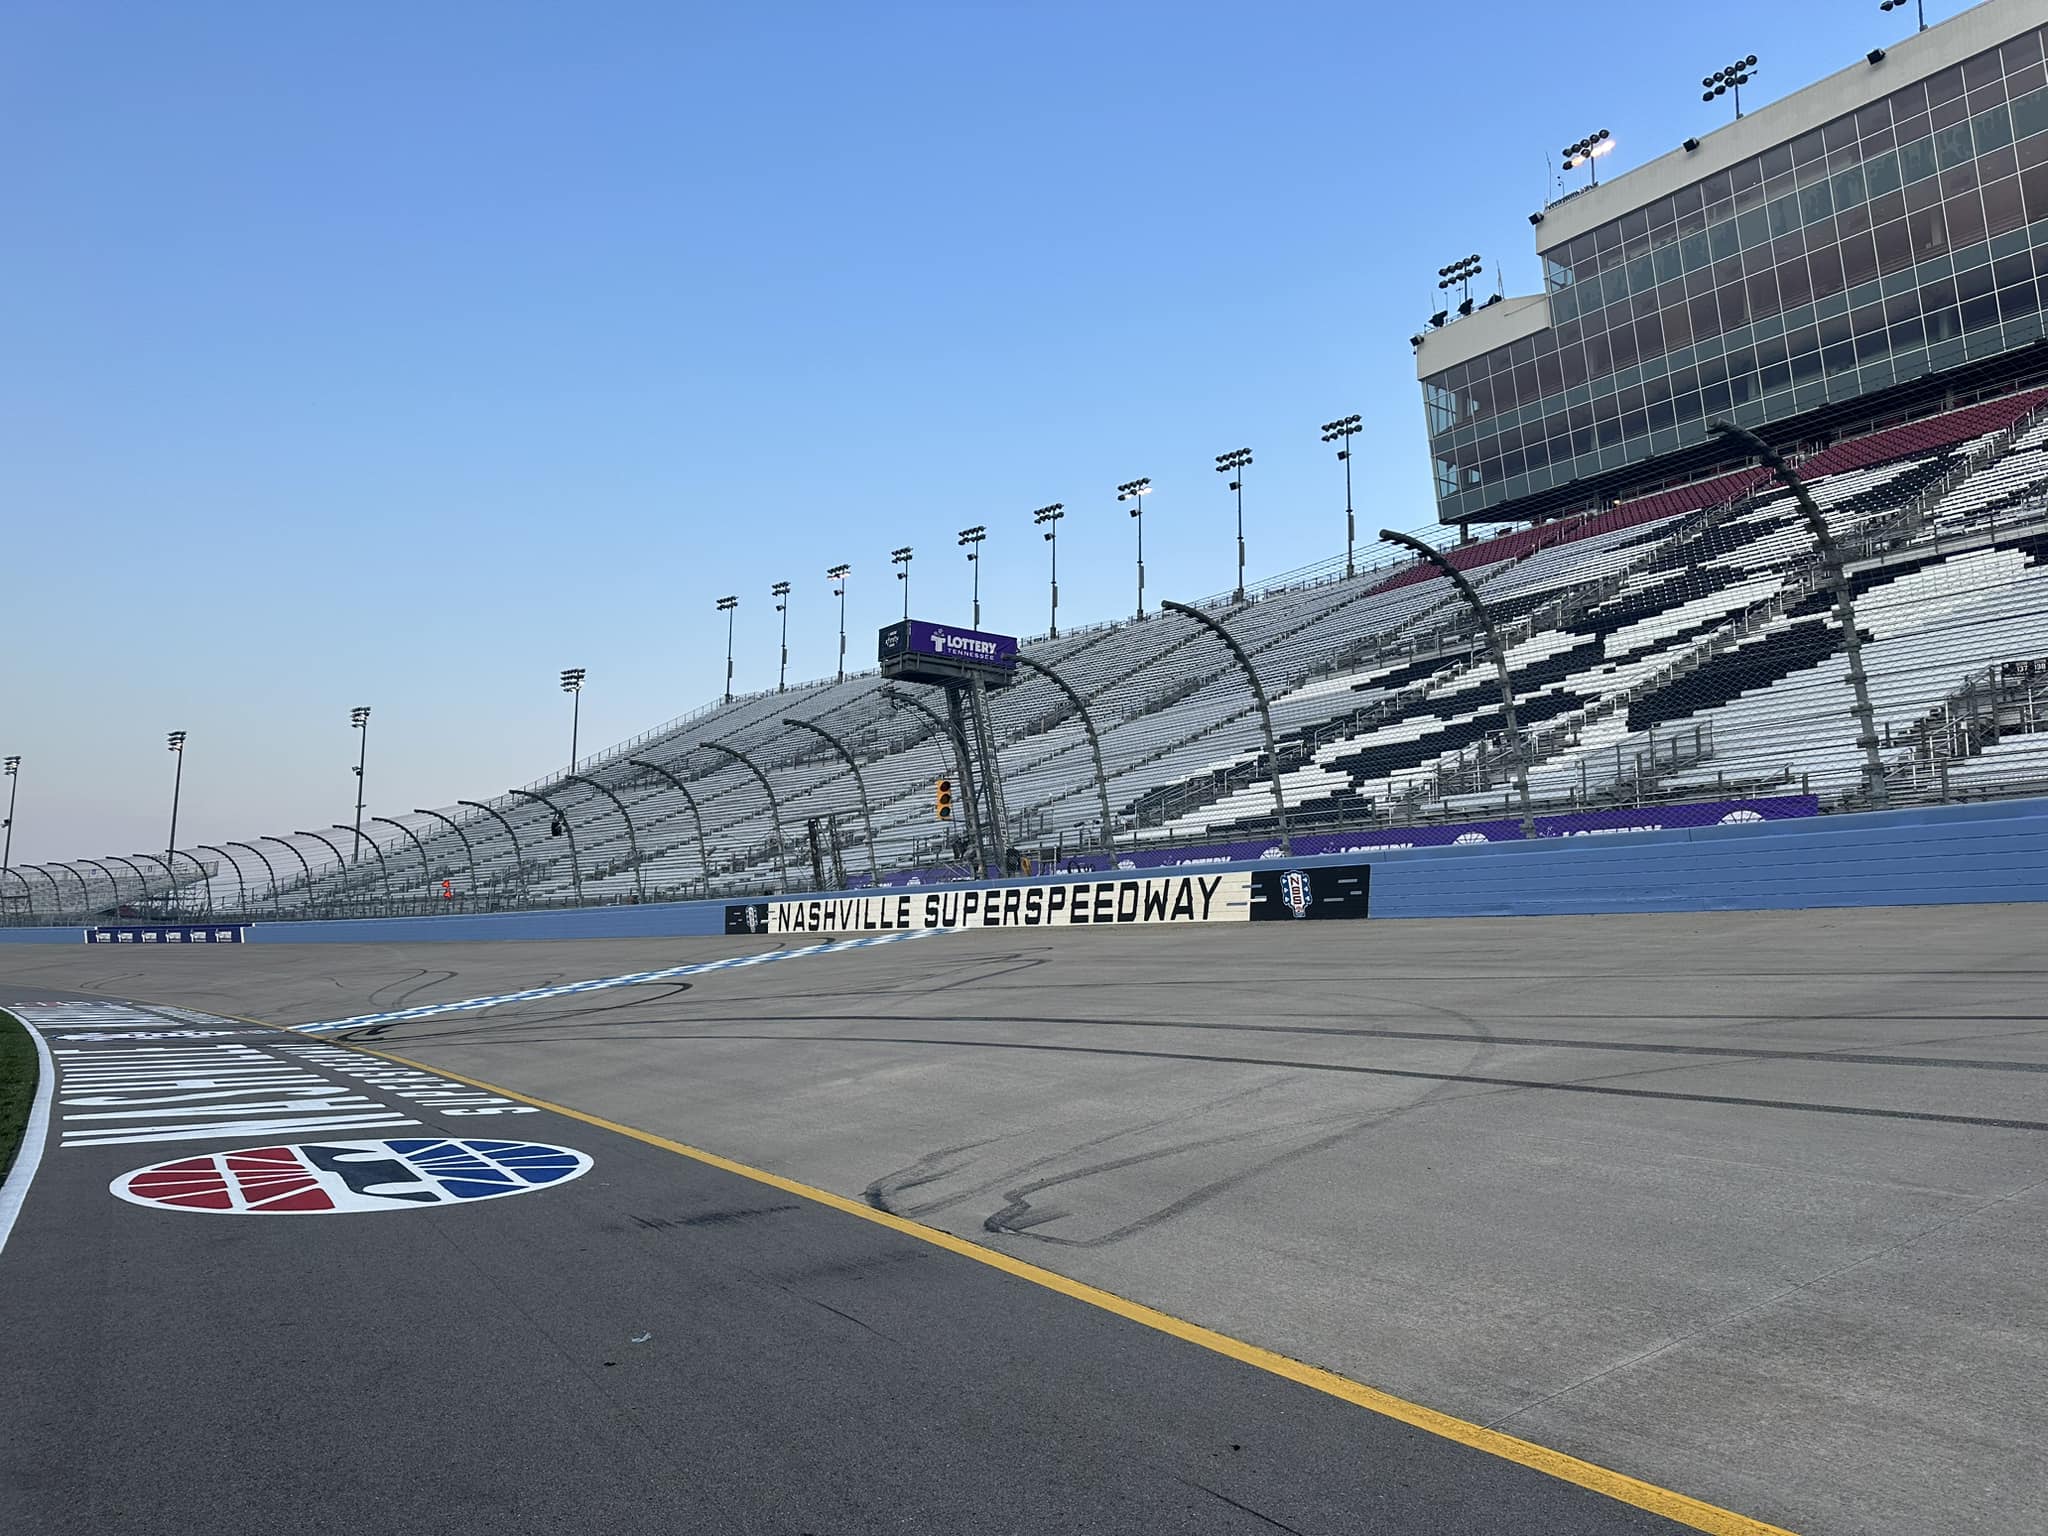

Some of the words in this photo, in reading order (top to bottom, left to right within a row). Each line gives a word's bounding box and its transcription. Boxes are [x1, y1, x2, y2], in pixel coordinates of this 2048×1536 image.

[947, 635, 996, 654] LOTTERY
[947, 648, 995, 660] TENNESSEE
[977, 688, 995, 756] NASHVILLE
[989, 758, 1009, 854] SUPERSPEEDWA
[778, 896, 911, 932] NASHVILLE
[924, 876, 1223, 928] SUPERSPEEDWAY
[53, 1044, 423, 1147] NASHVILLE
